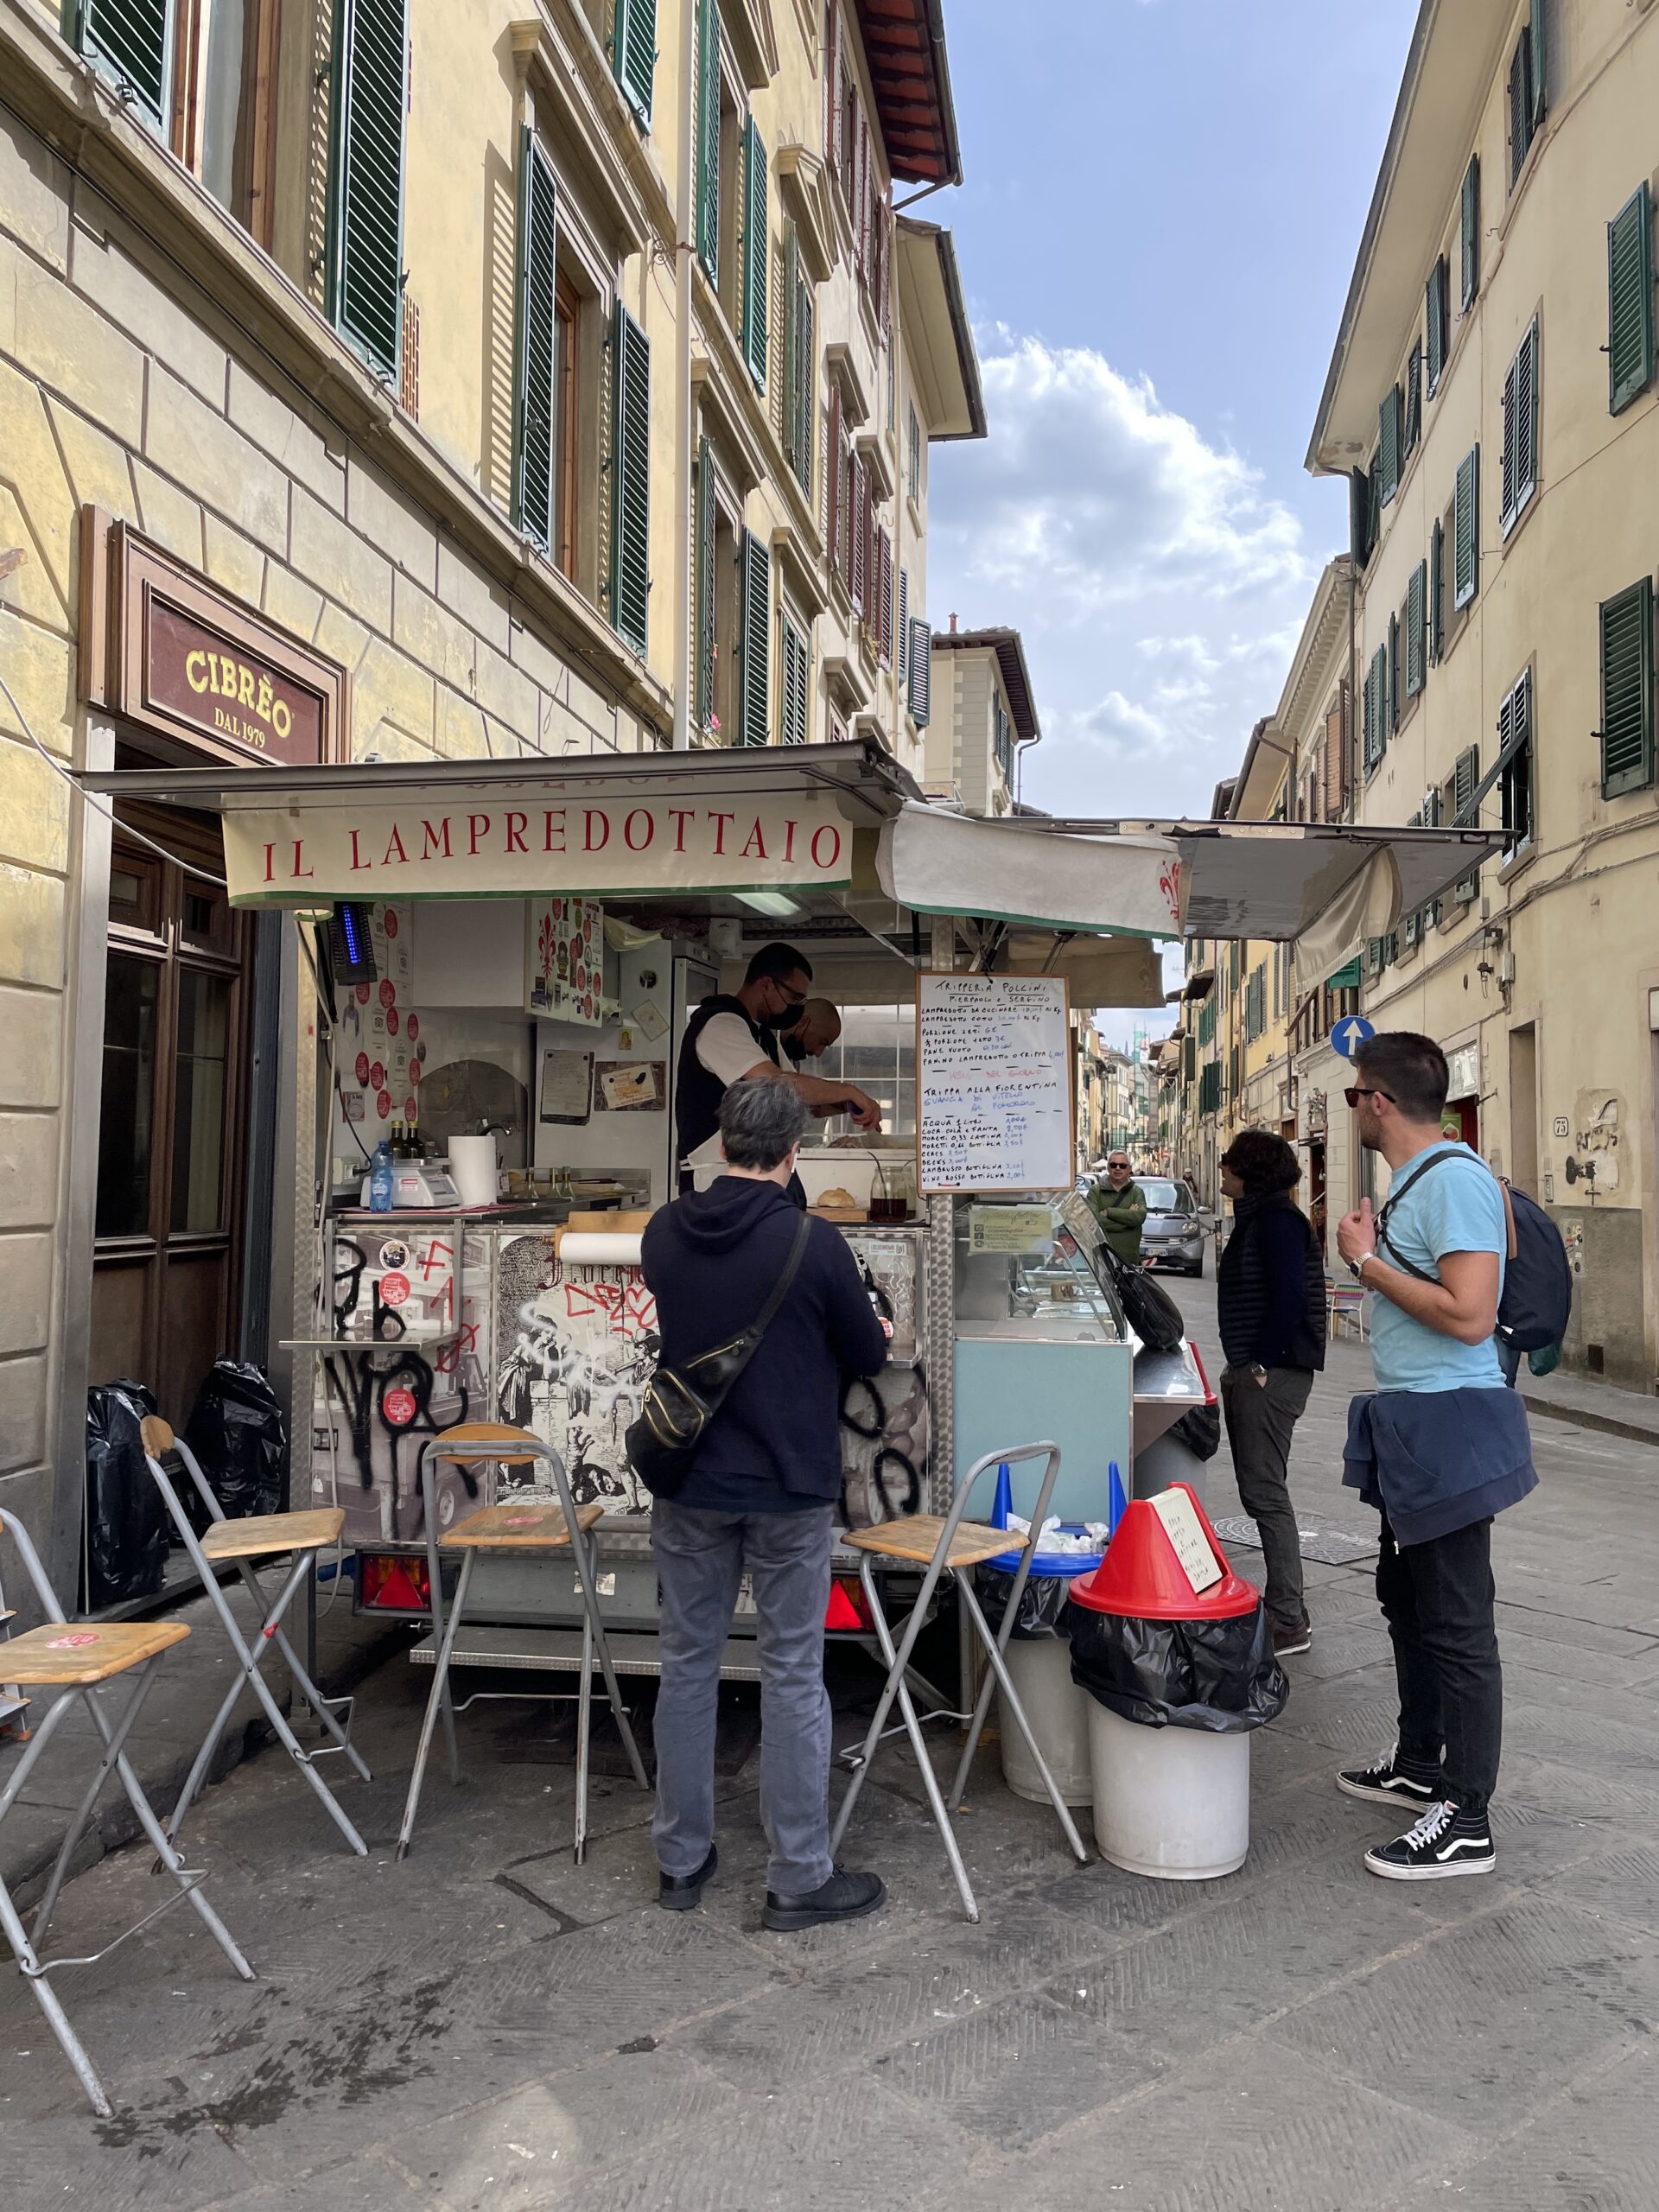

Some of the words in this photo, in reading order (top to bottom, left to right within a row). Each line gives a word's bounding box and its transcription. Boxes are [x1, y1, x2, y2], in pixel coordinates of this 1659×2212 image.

[186, 650, 291, 738] CIBRÈO
[214, 707, 240, 736] DAL
[242, 721, 265, 748] 1979
[263, 838, 315, 882] IL
[348, 808, 842, 870] LAMPREDOTTAIO
[923, 1058, 953, 1066] PANINO
[924, 1087, 960, 1096] TRIPPA
[966, 1085, 991, 1094] ALLA
[995, 1082, 1058, 1092] FIORENTINA
[1556, 1120, 1567, 1134] 75
